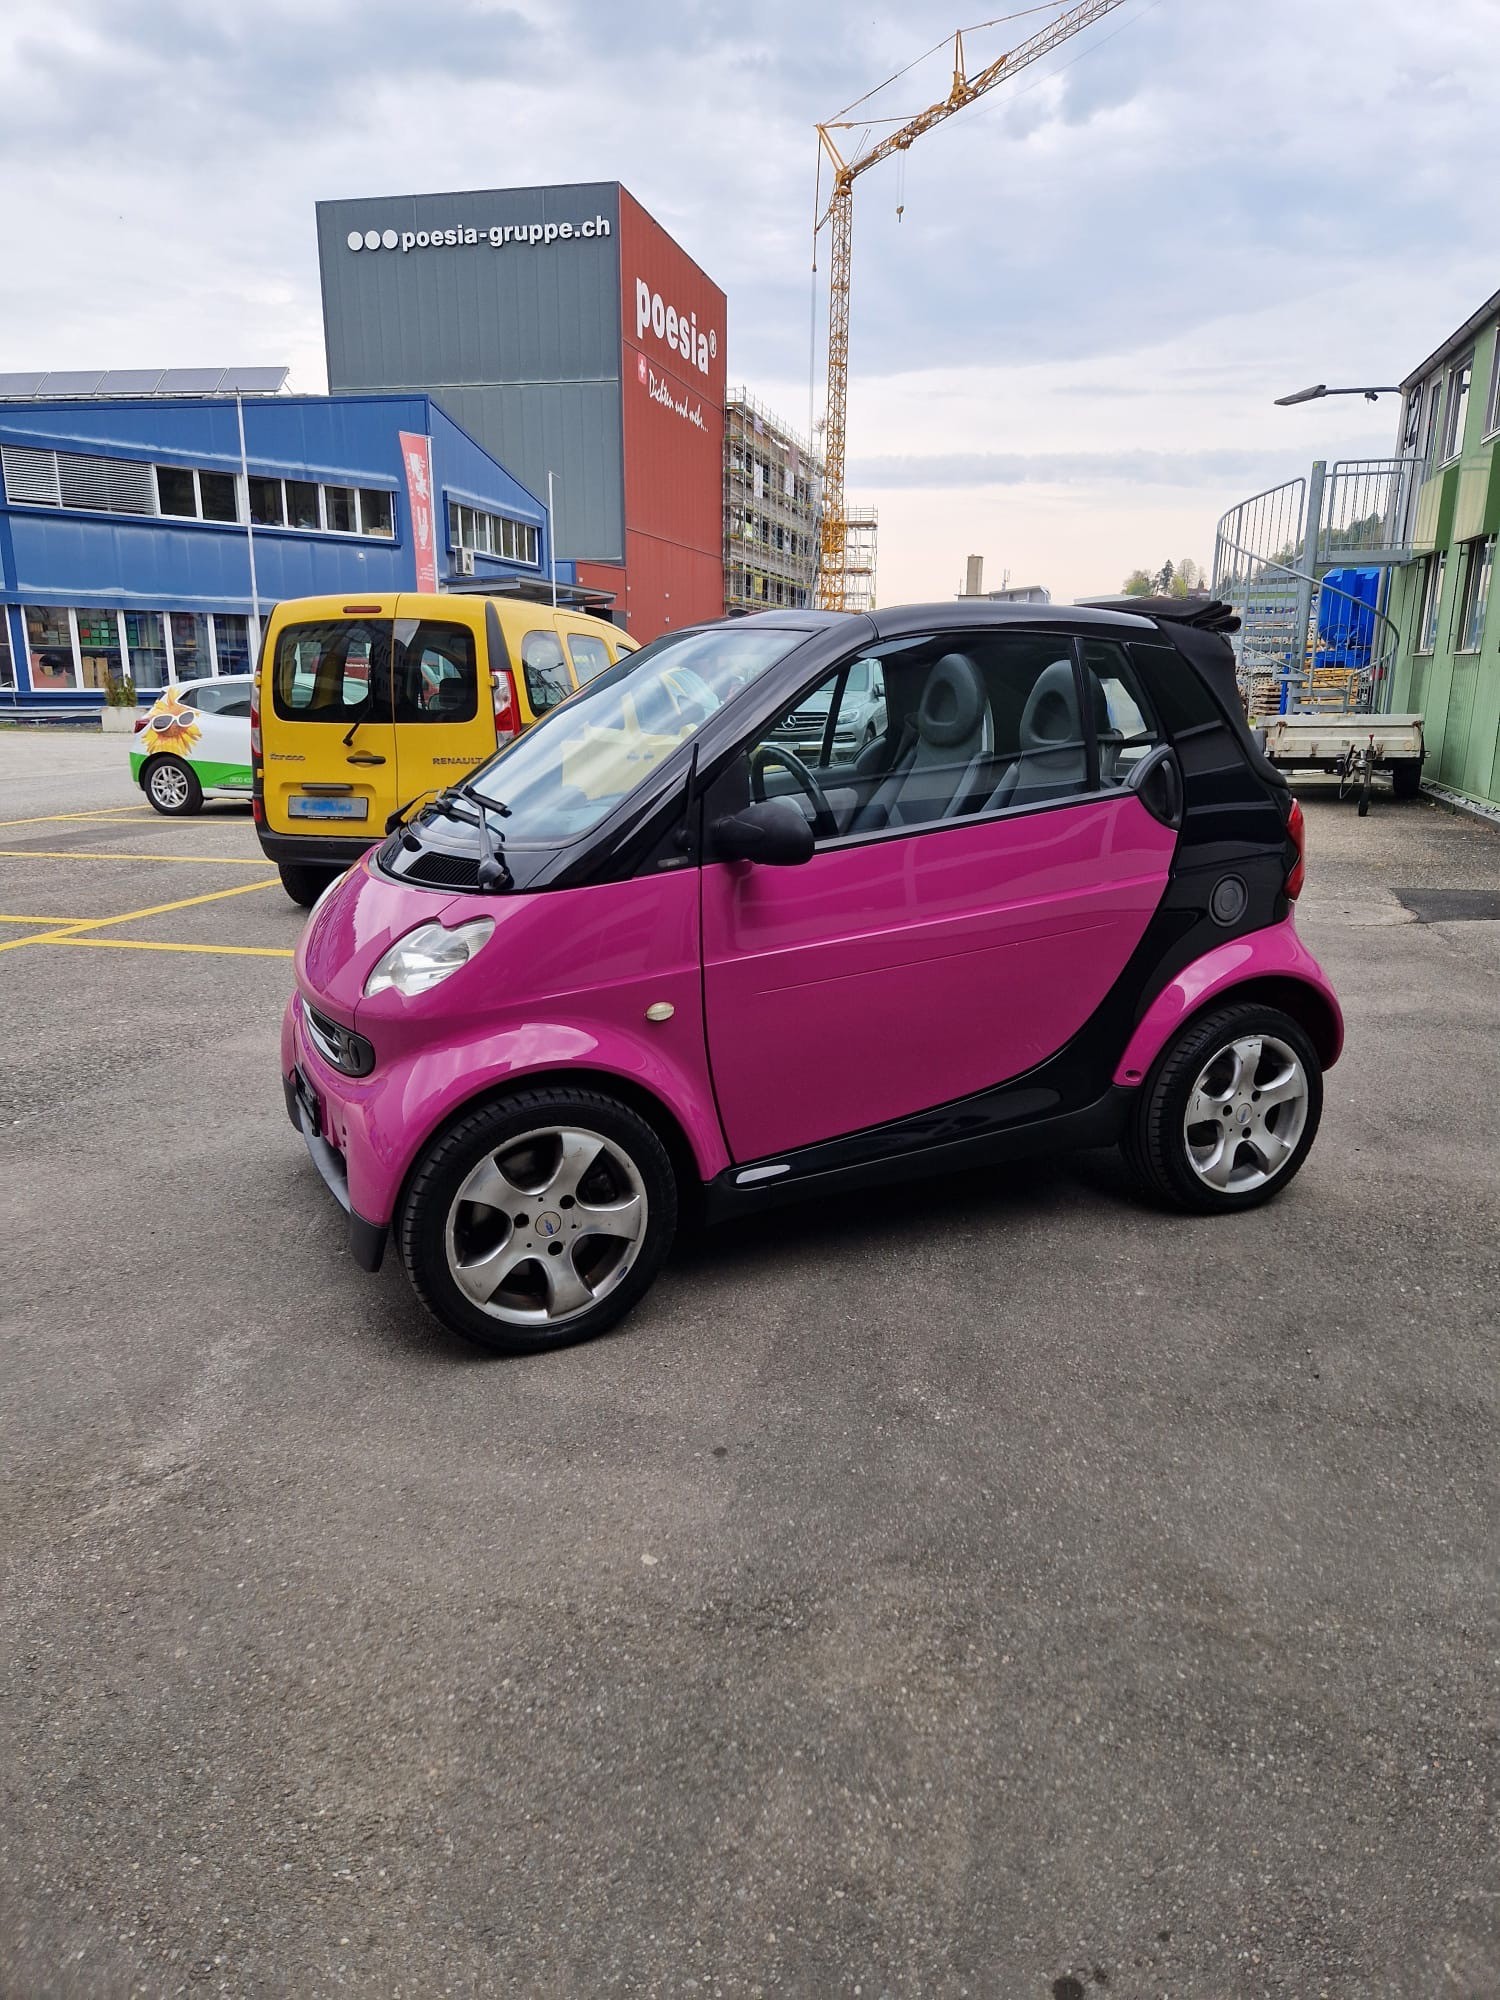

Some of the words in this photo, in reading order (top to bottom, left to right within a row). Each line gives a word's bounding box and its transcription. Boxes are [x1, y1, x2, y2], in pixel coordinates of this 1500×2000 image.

[402, 215, 611, 251] poesia-gruppe.ch
[675, 396, 689, 418] und
[432, 757, 484, 765] RENAULT
